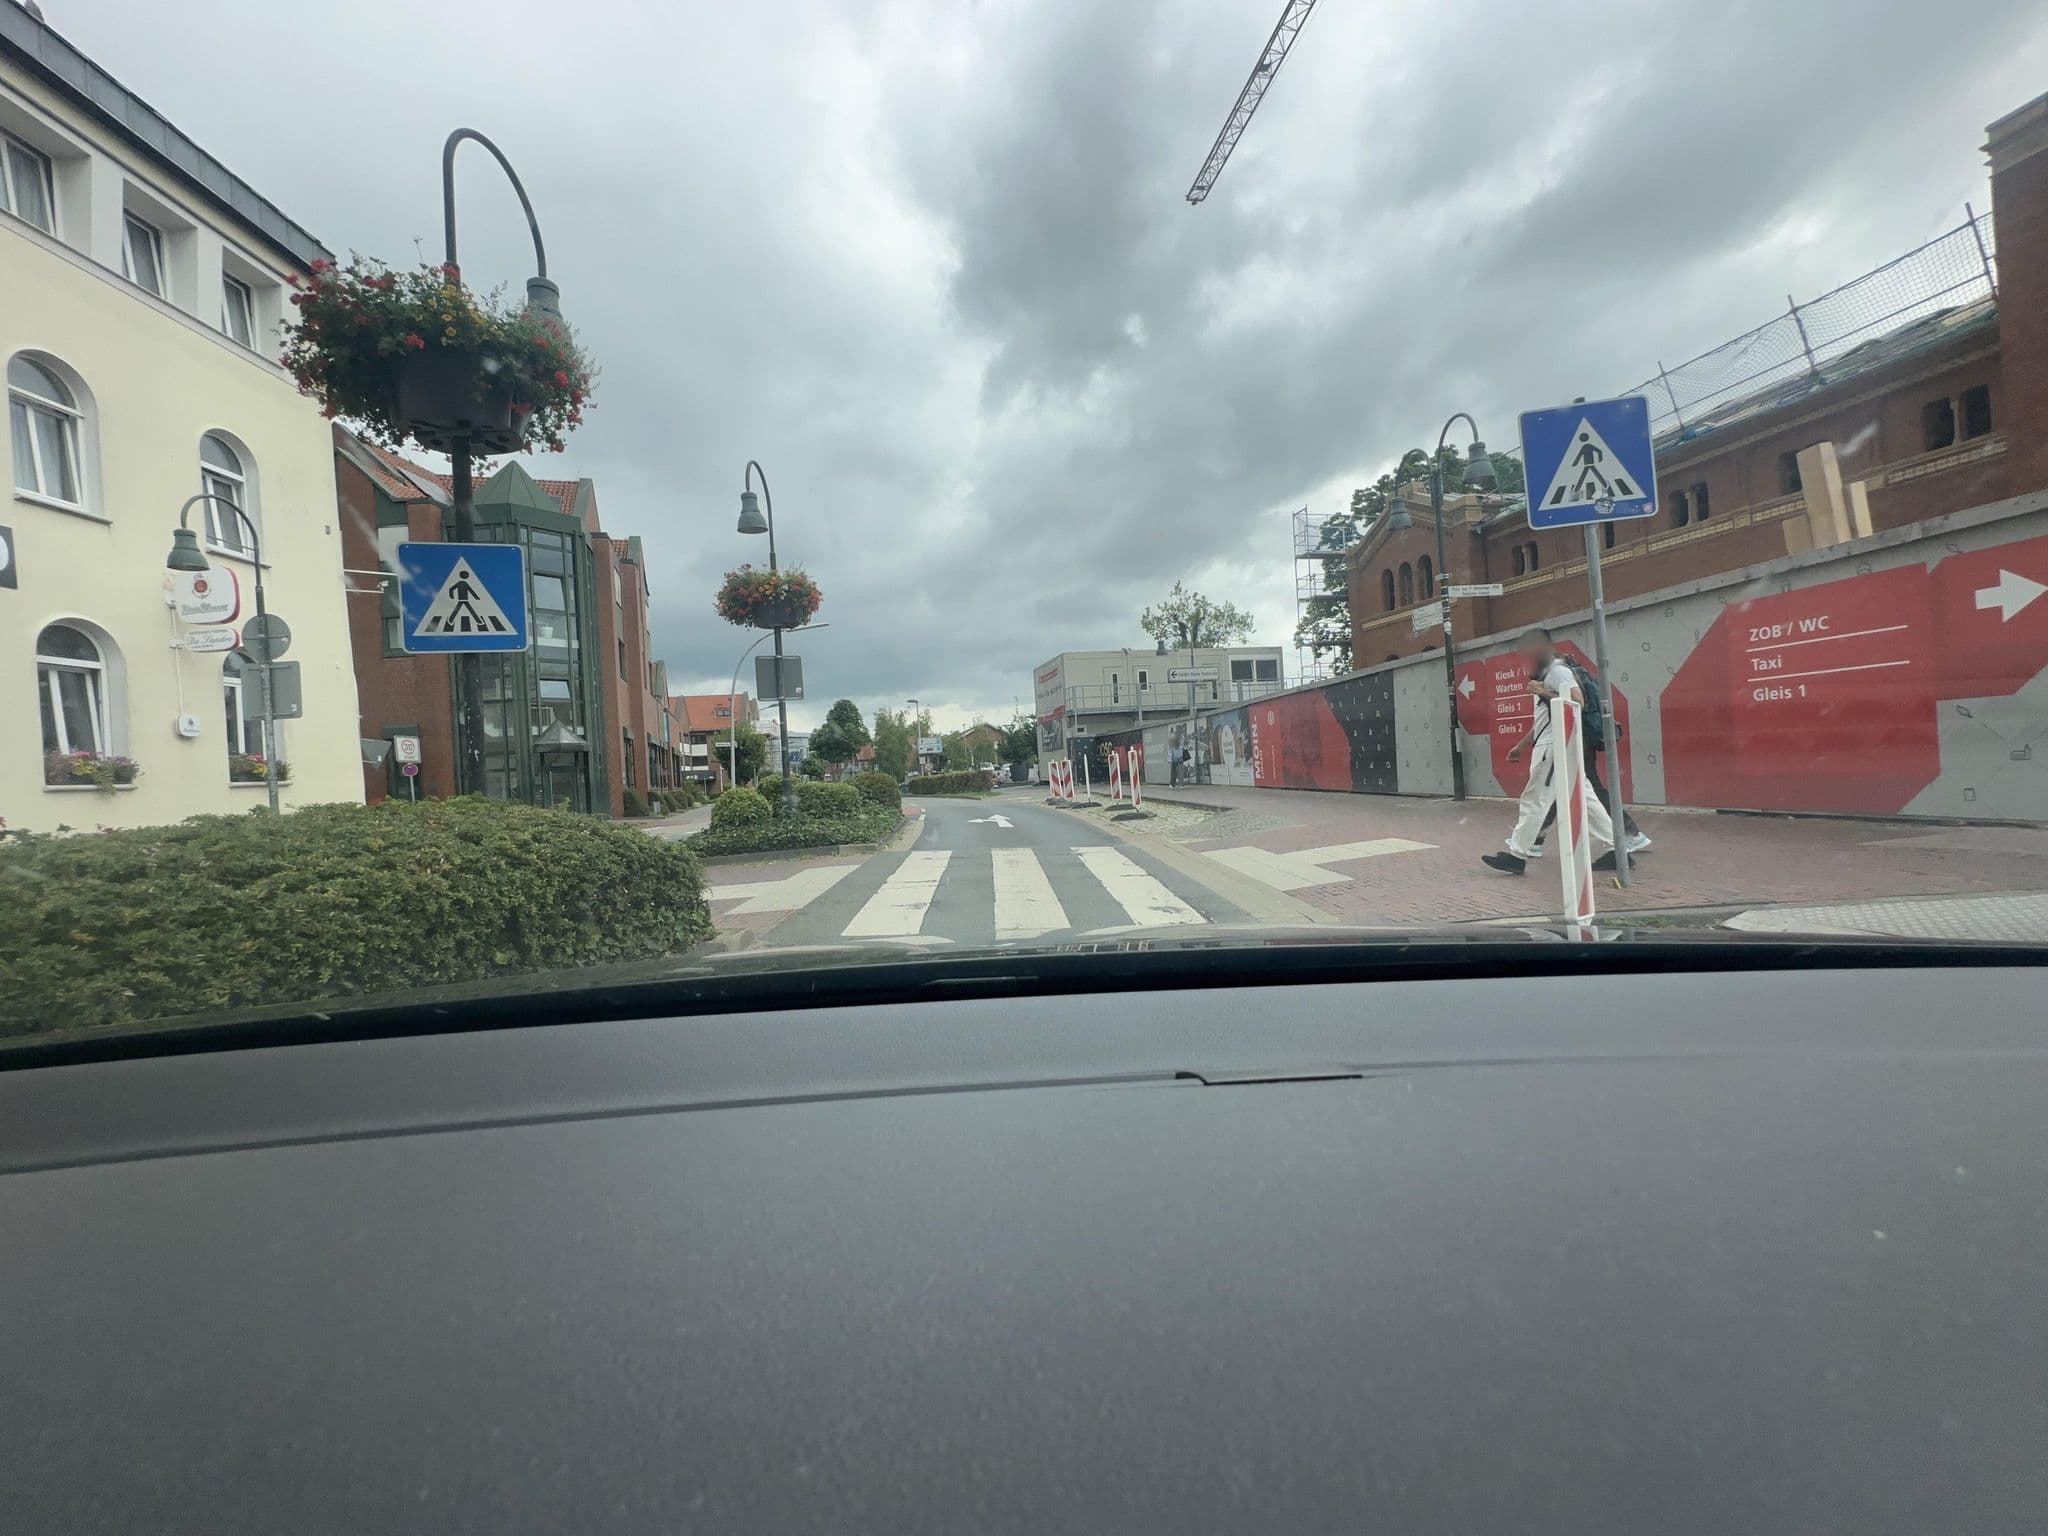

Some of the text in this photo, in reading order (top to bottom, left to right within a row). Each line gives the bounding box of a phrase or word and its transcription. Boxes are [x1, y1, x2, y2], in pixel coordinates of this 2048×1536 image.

[1749, 616, 1829, 642] ZOB / WC
[1751, 654, 1782, 672] Taxi
[1495, 669, 1515, 681] Kiosk
[1496, 683, 1523, 694] Warten
[1753, 684, 1806, 702] Gleis 1
[1497, 702, 1521, 713] Gleis 1
[1498, 723, 1524, 734] Gleis 2
[404, 743, 413, 751] 30
